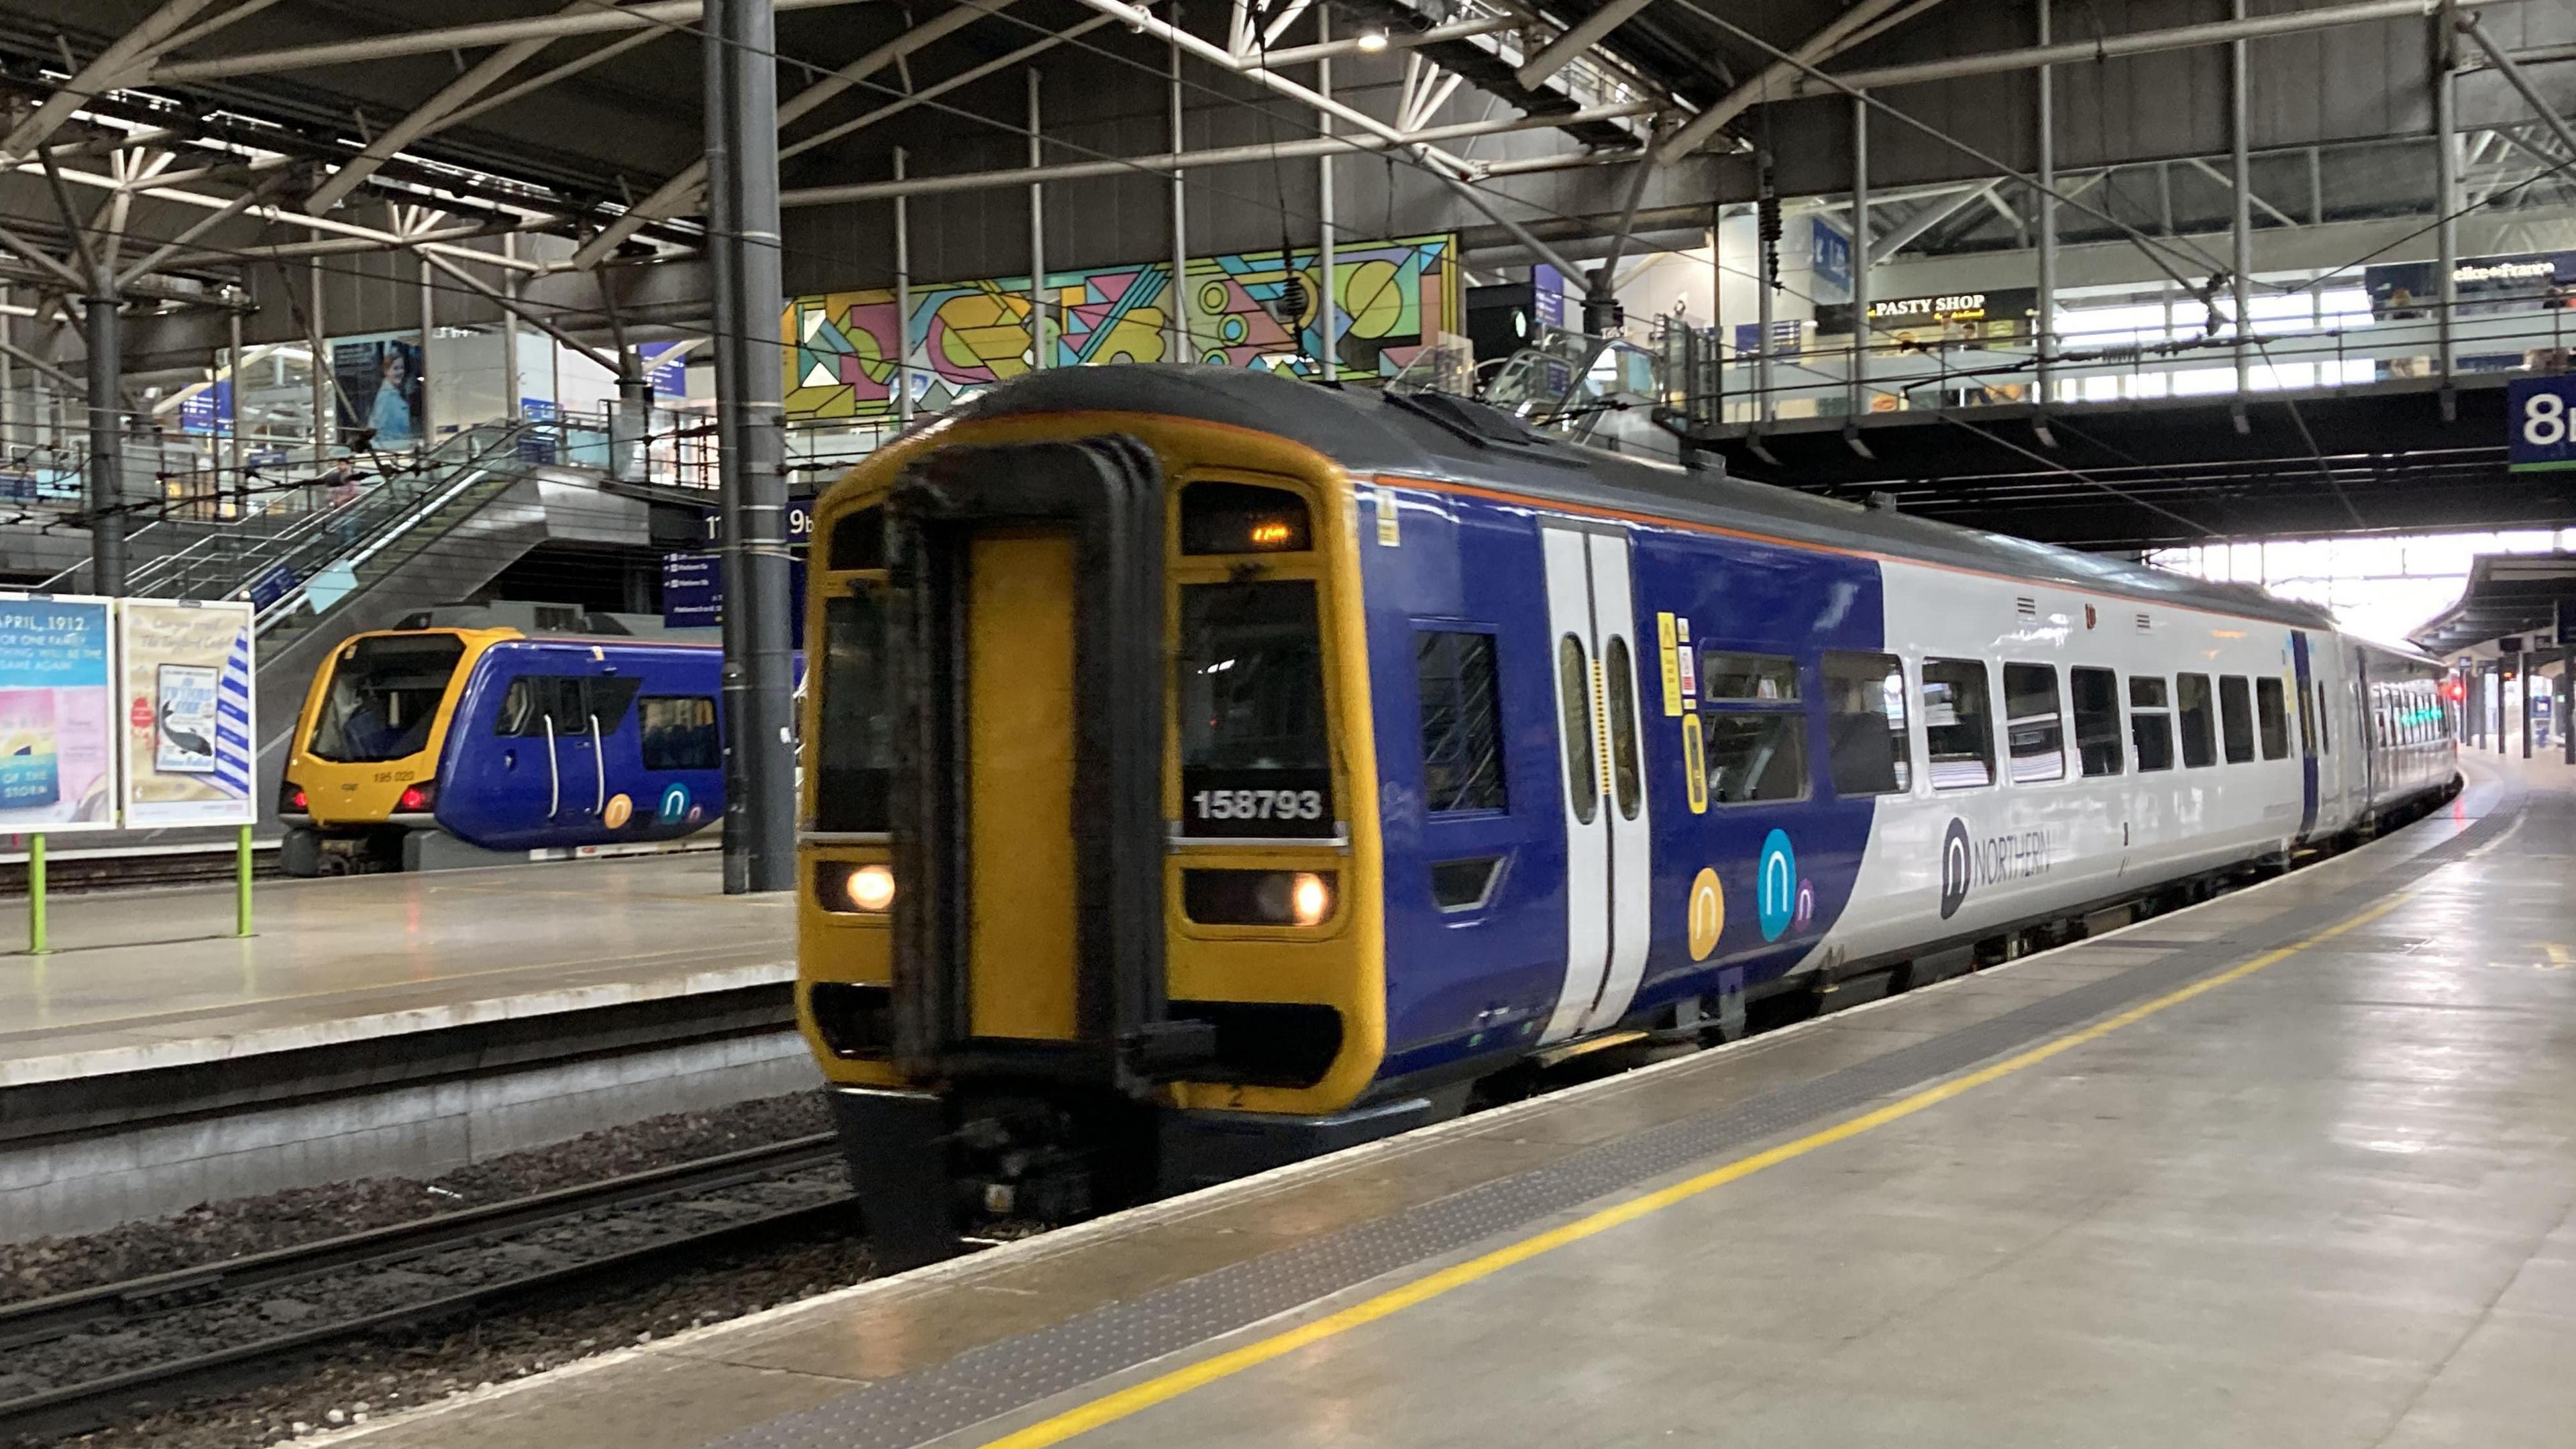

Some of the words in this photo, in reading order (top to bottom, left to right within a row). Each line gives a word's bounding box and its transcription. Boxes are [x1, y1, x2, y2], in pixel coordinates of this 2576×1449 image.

[1876, 299, 1932, 316] PASTY
[1935, 294, 1984, 311] SHOP
[2524, 393, 2576, 445] 8
[1192, 790, 1322, 819] 158793
[1974, 830, 2050, 888] NORTHERN
